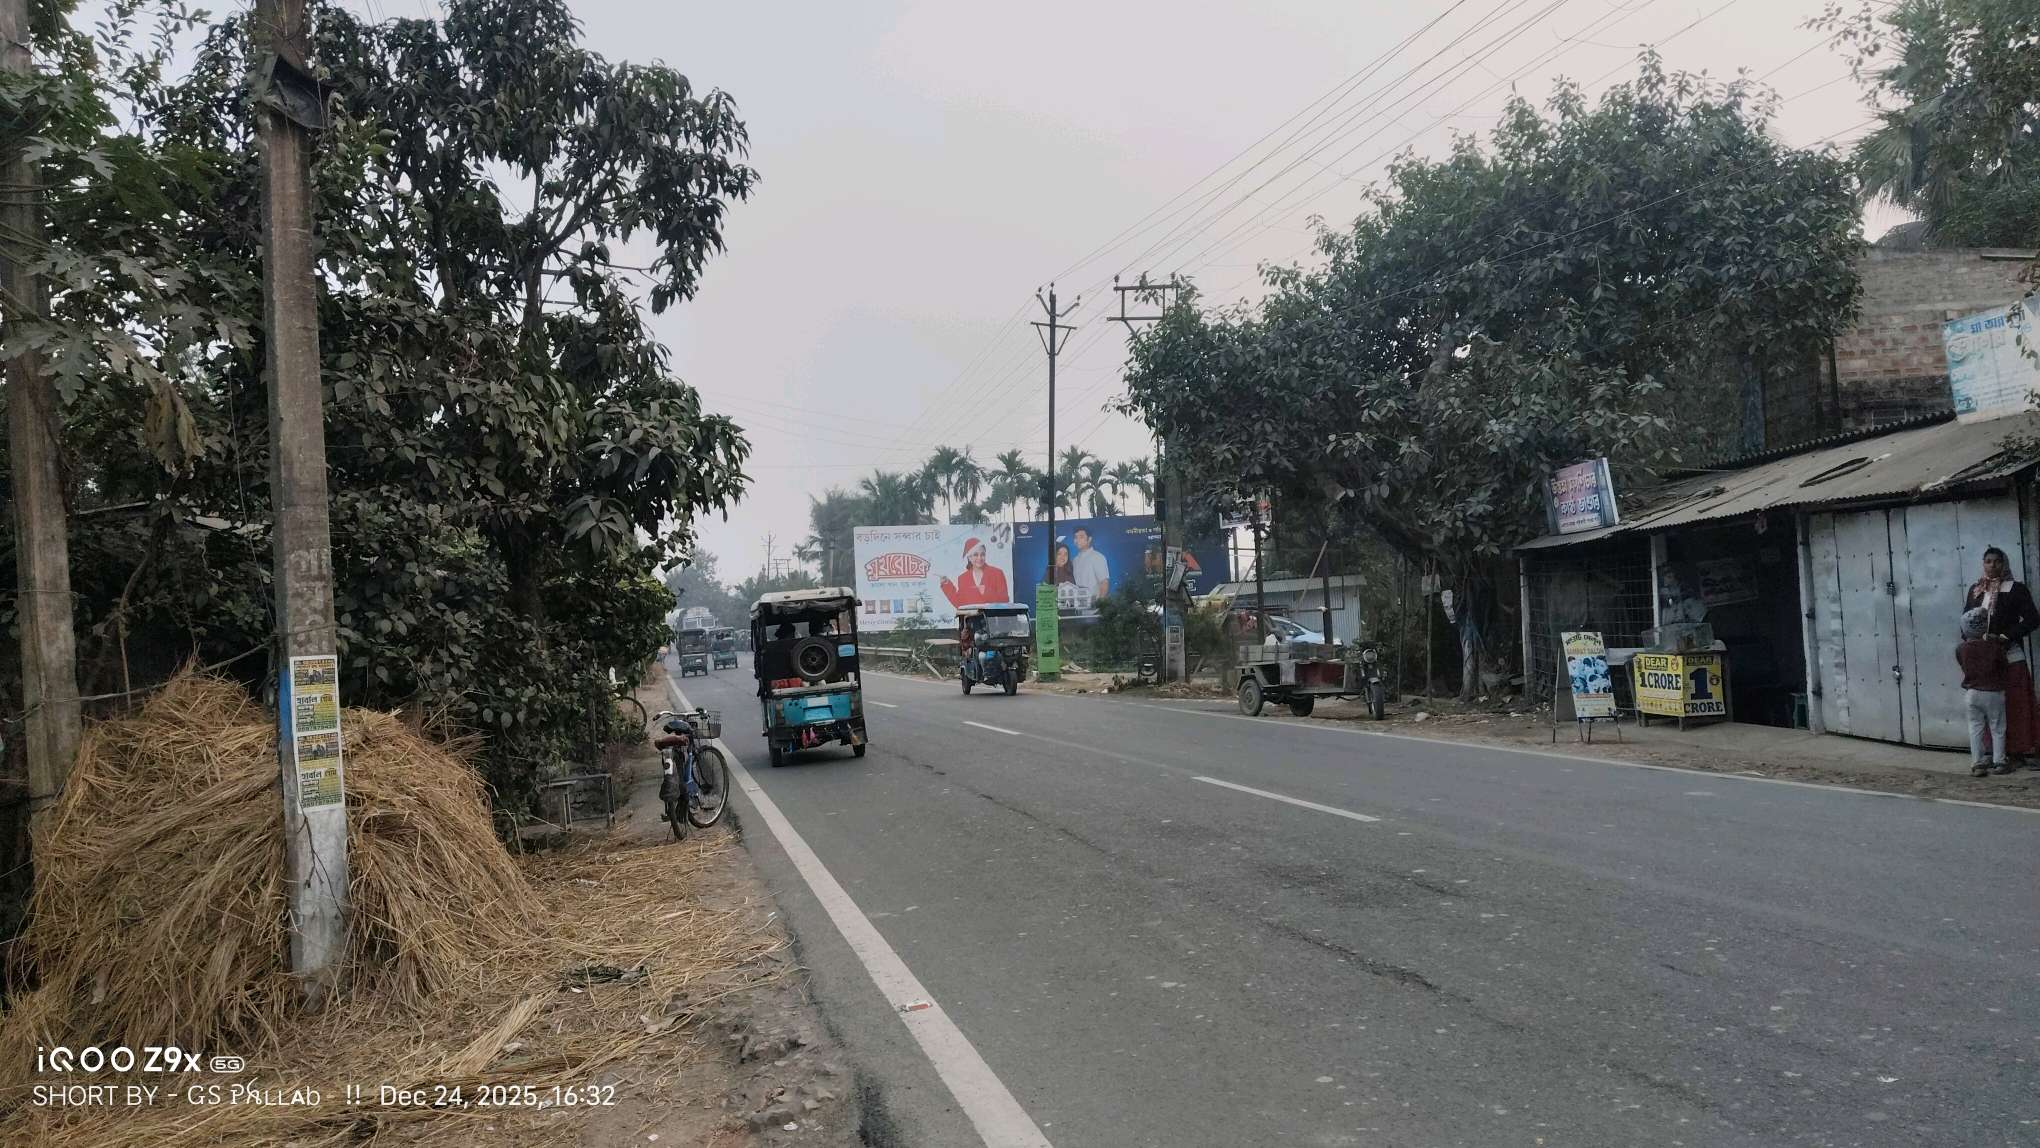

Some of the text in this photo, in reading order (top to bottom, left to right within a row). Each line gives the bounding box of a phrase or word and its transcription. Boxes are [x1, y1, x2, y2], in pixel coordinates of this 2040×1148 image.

[1645, 657, 1667, 666] DEAR
[1647, 672, 1682, 691] CRORE
[1690, 667, 1713, 700] 1
[1684, 702, 1723, 714] CRORE
